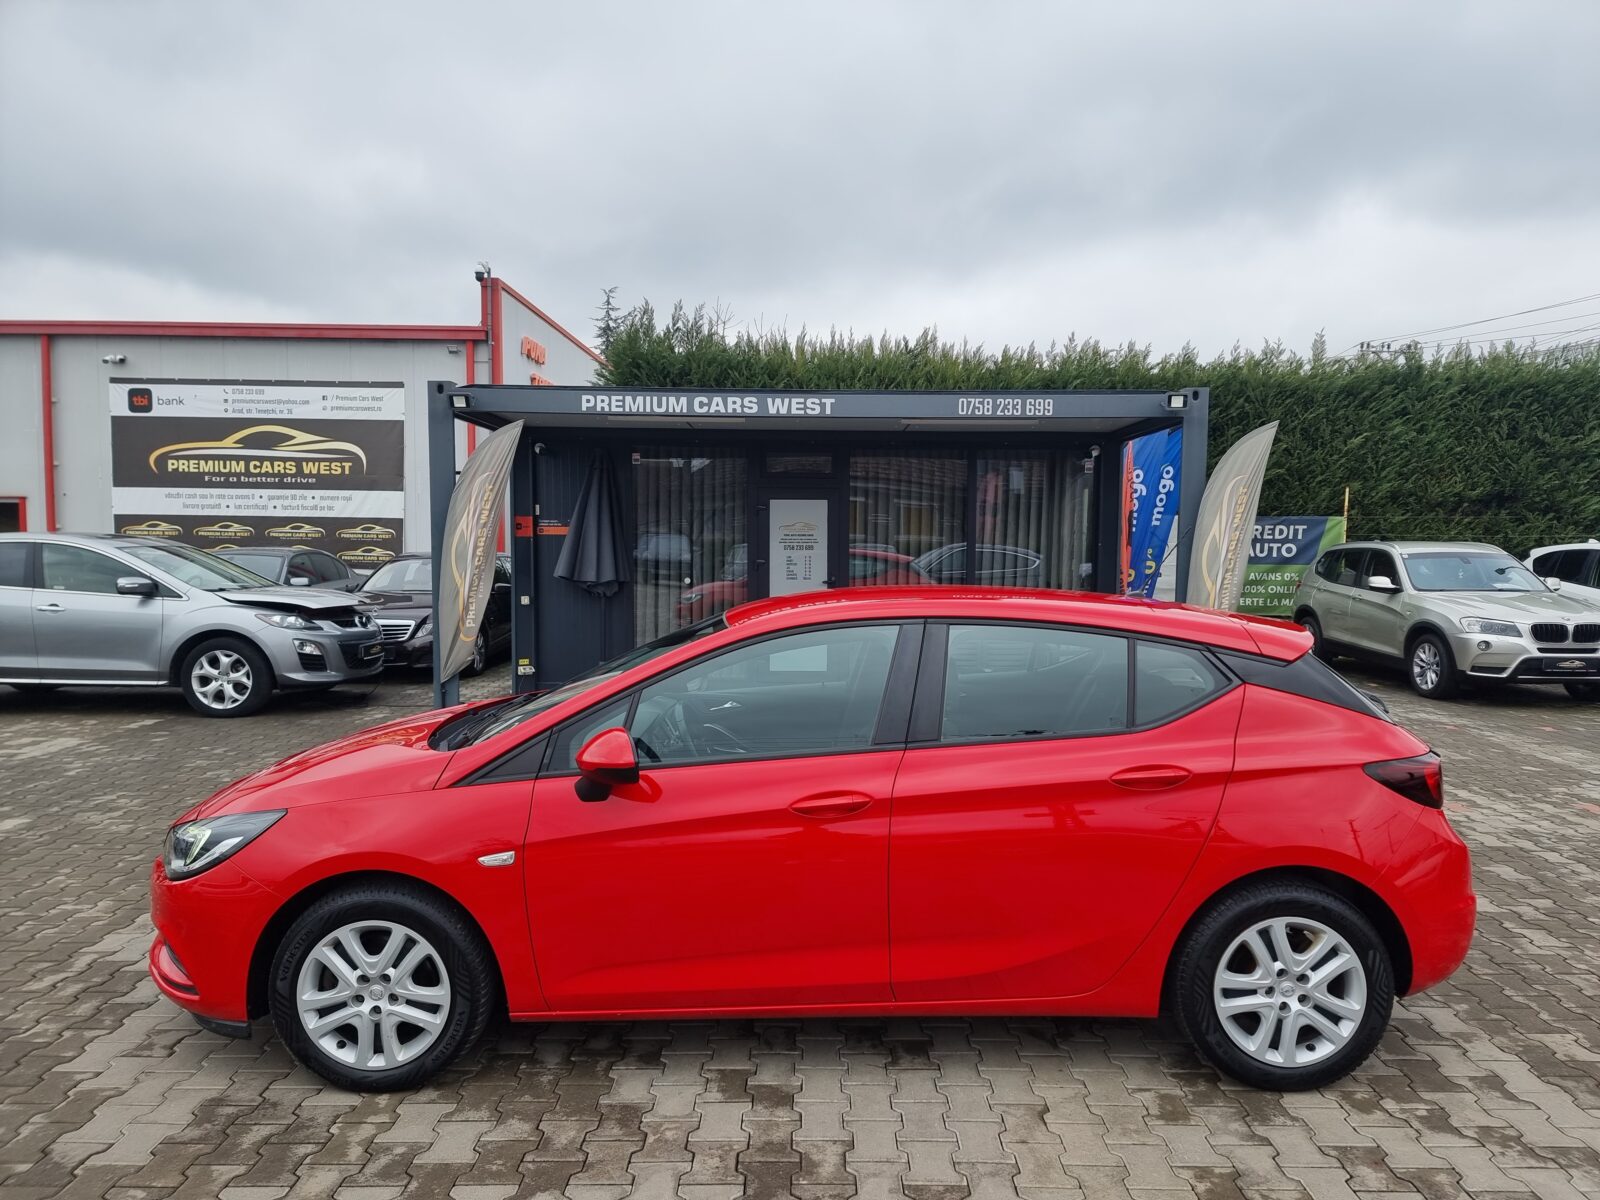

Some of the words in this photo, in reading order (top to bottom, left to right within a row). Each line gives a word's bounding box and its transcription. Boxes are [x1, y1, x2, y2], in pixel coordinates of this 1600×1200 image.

[132, 395, 149, 406] tbi
[157, 396, 185, 406] bank
[581, 395, 688, 413] PREMIUM
[693, 397, 759, 414] CARS
[767, 398, 836, 415] WEST
[958, 398, 993, 415] 0758
[996, 398, 1022, 415] 233
[1026, 399, 1054, 416] 699
[167, 459, 245, 473] PREMIUM
[250, 461, 297, 474] CARS
[302, 462, 353, 475] WEST
[1151, 463, 1175, 526] mogo
[1252, 525, 1308, 540] REDIT
[474, 527, 487, 565] CARS
[1248, 572, 1282, 581] AVANS
[1284, 572, 1299, 581] 0%
[1240, 597, 1265, 606] ERTE
